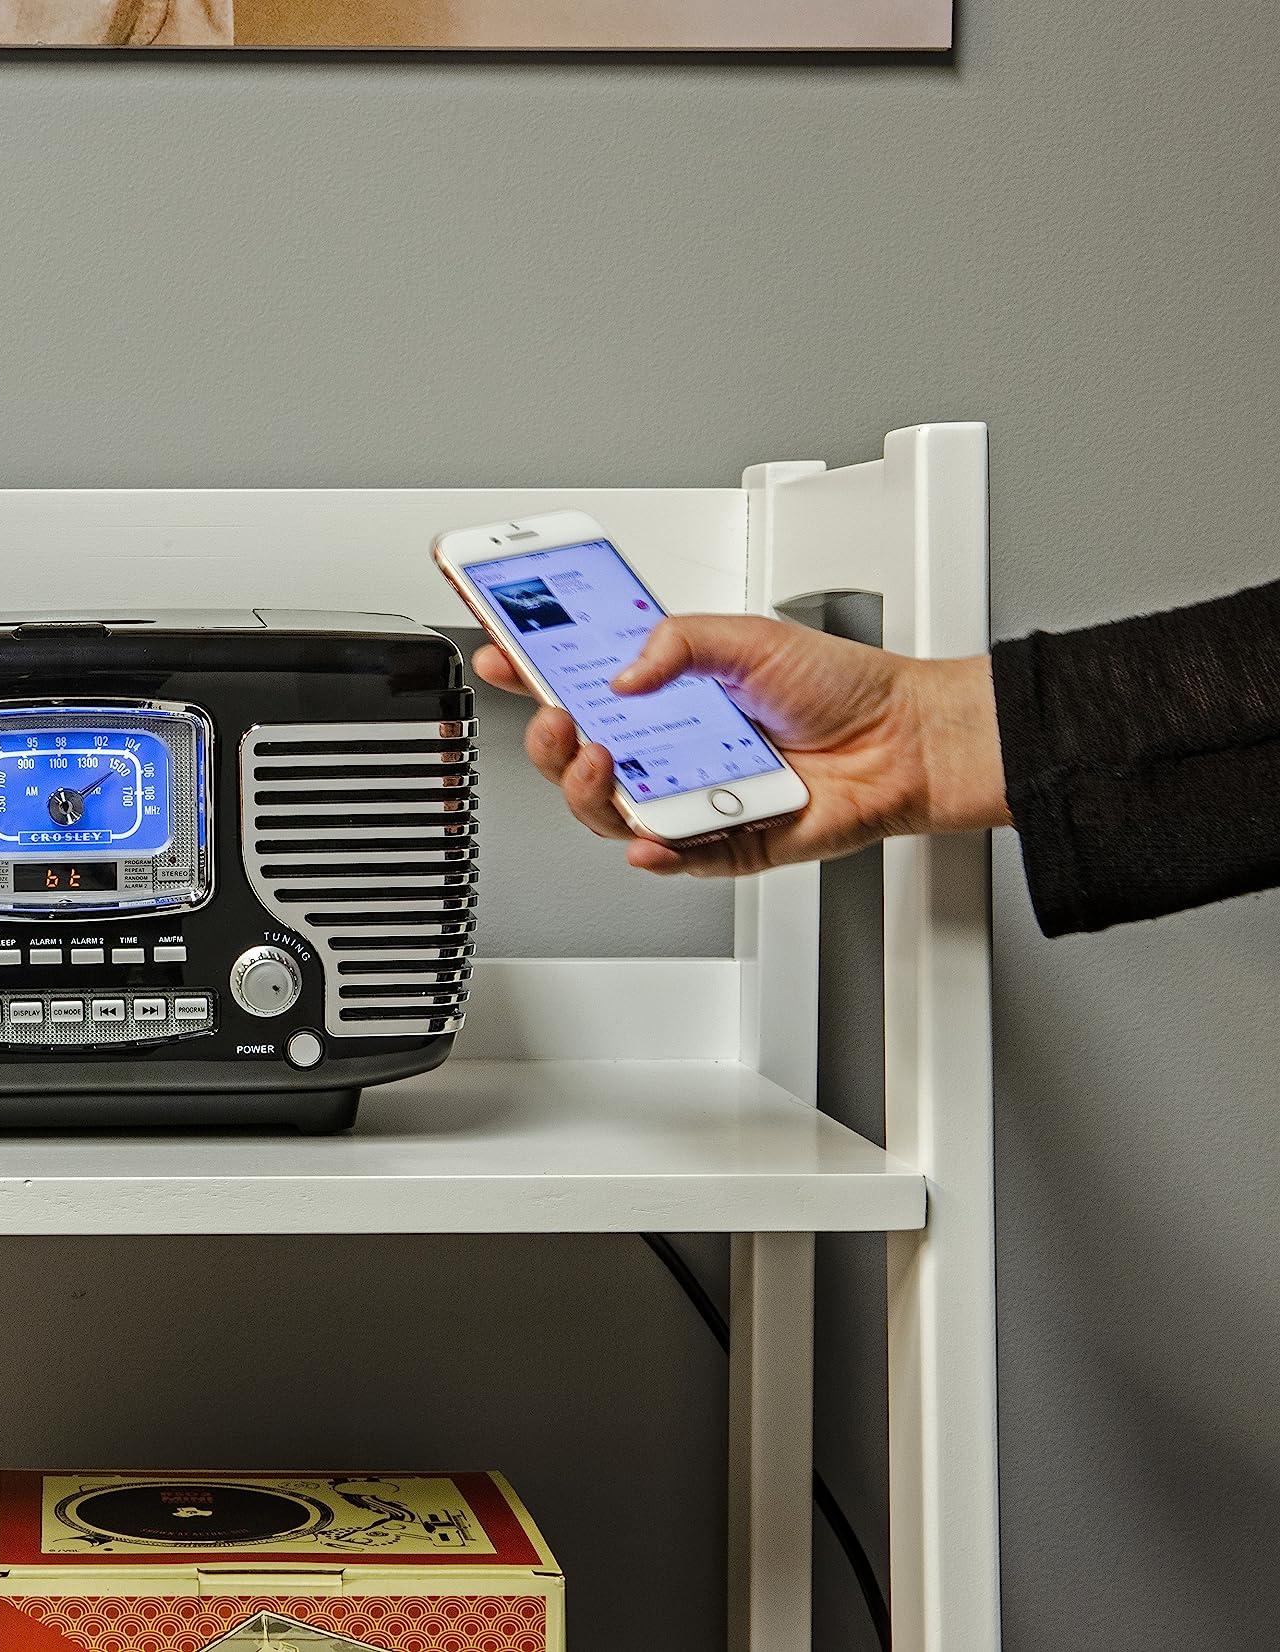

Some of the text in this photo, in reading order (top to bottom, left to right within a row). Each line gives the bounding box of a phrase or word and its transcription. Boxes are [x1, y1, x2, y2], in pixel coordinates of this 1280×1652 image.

[26, 737, 39, 748] 95
[55, 736, 67, 748] 98
[93, 735, 109, 747] 102
[124, 737, 141, 752] 104
[17, 757, 131, 777] 900 1100 1300 1500
[143, 761, 155, 778] 106
[25, 786, 39, 796] AM
[122, 785, 134, 807] 1700
[144, 785, 156, 801] 108
[144, 805, 161, 815] MHz
[29, 832, 102, 843] CROSLEY
[29, 938, 57, 946] ALARM
[70, 937, 104, 945] ALARM 2
[119, 936, 138, 944] TIME
[158, 935, 184, 943] AM/FM
[263, 931, 312, 962] TUNING
[13, 1009, 40, 1017] DISPLAY
[63, 1008, 81, 1016] MODE
[178, 1006, 206, 1014] PROGRAM
[236, 1044, 275, 1054] POWER
